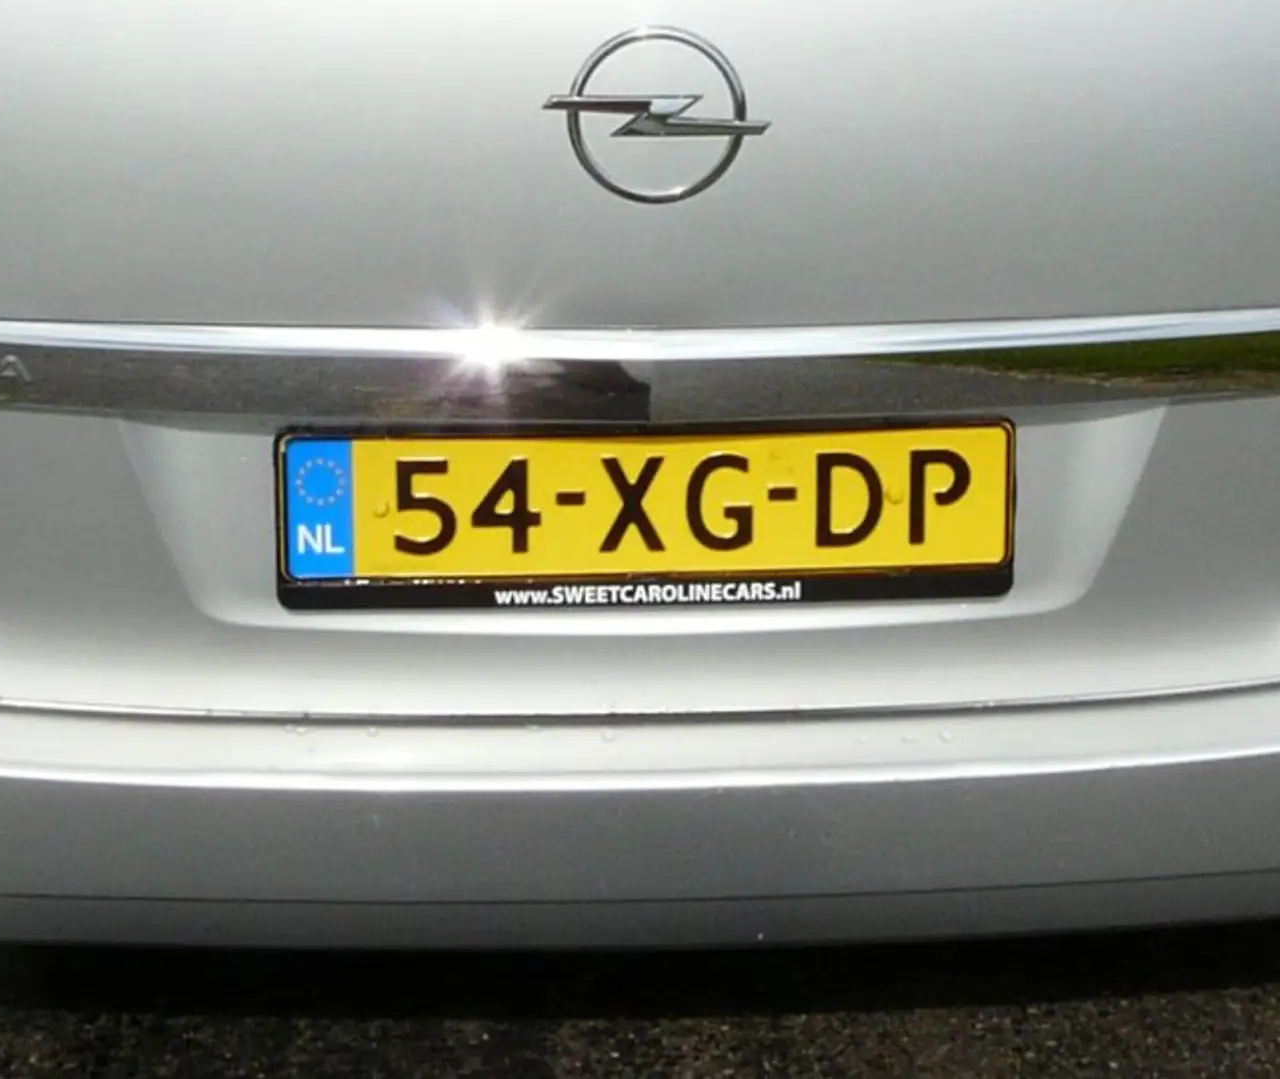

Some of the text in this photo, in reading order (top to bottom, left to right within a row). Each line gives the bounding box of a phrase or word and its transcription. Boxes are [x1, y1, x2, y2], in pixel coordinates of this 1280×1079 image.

[393, 450, 972, 556] 54-XG-DP
[297, 523, 346, 554] NL
[495, 581, 802, 605] www.SWEETCAROLINECARS.nl
